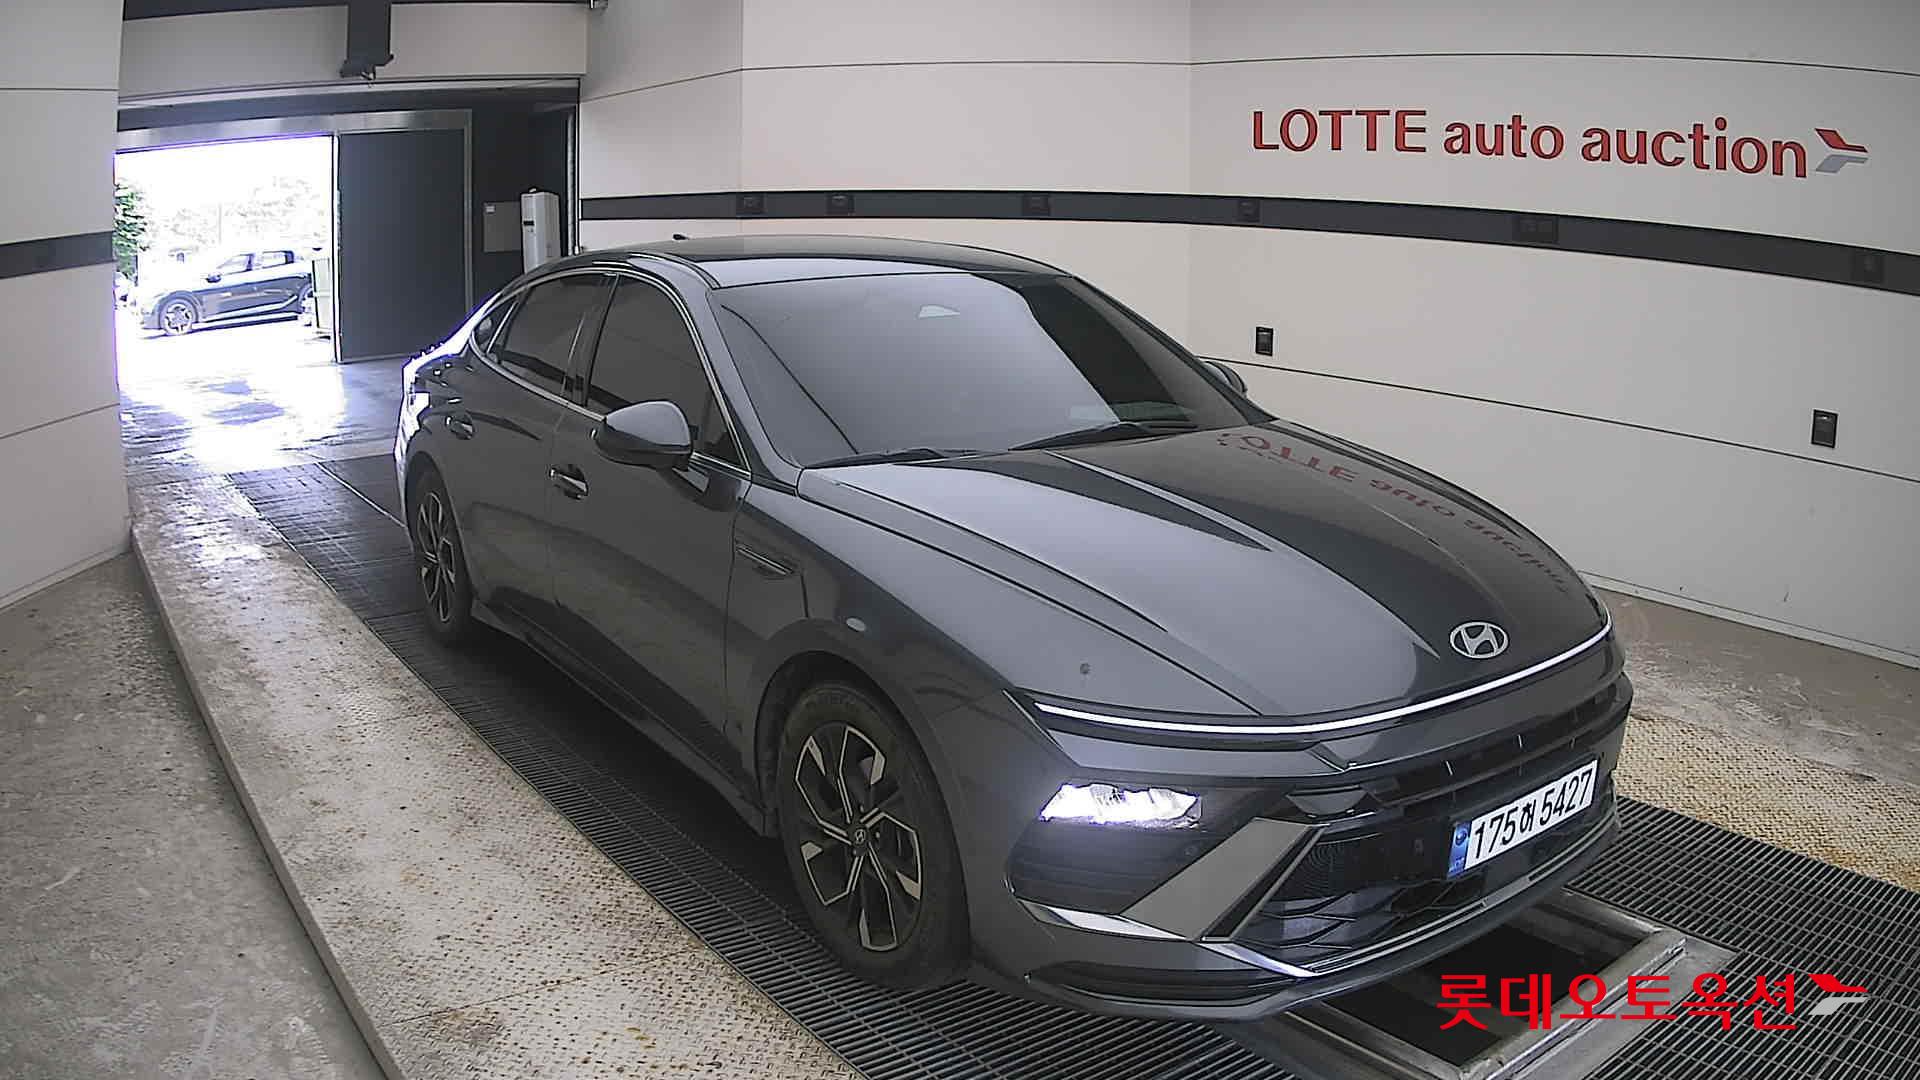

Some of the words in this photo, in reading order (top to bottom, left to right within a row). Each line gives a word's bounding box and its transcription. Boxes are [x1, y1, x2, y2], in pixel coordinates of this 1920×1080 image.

[1252, 109, 1427, 153] LOTTE
[1443, 114, 1565, 160] auto
[1581, 117, 1808, 178] auction
[1474, 798, 1537, 859] 175허
[1539, 768, 1593, 826] 5427
